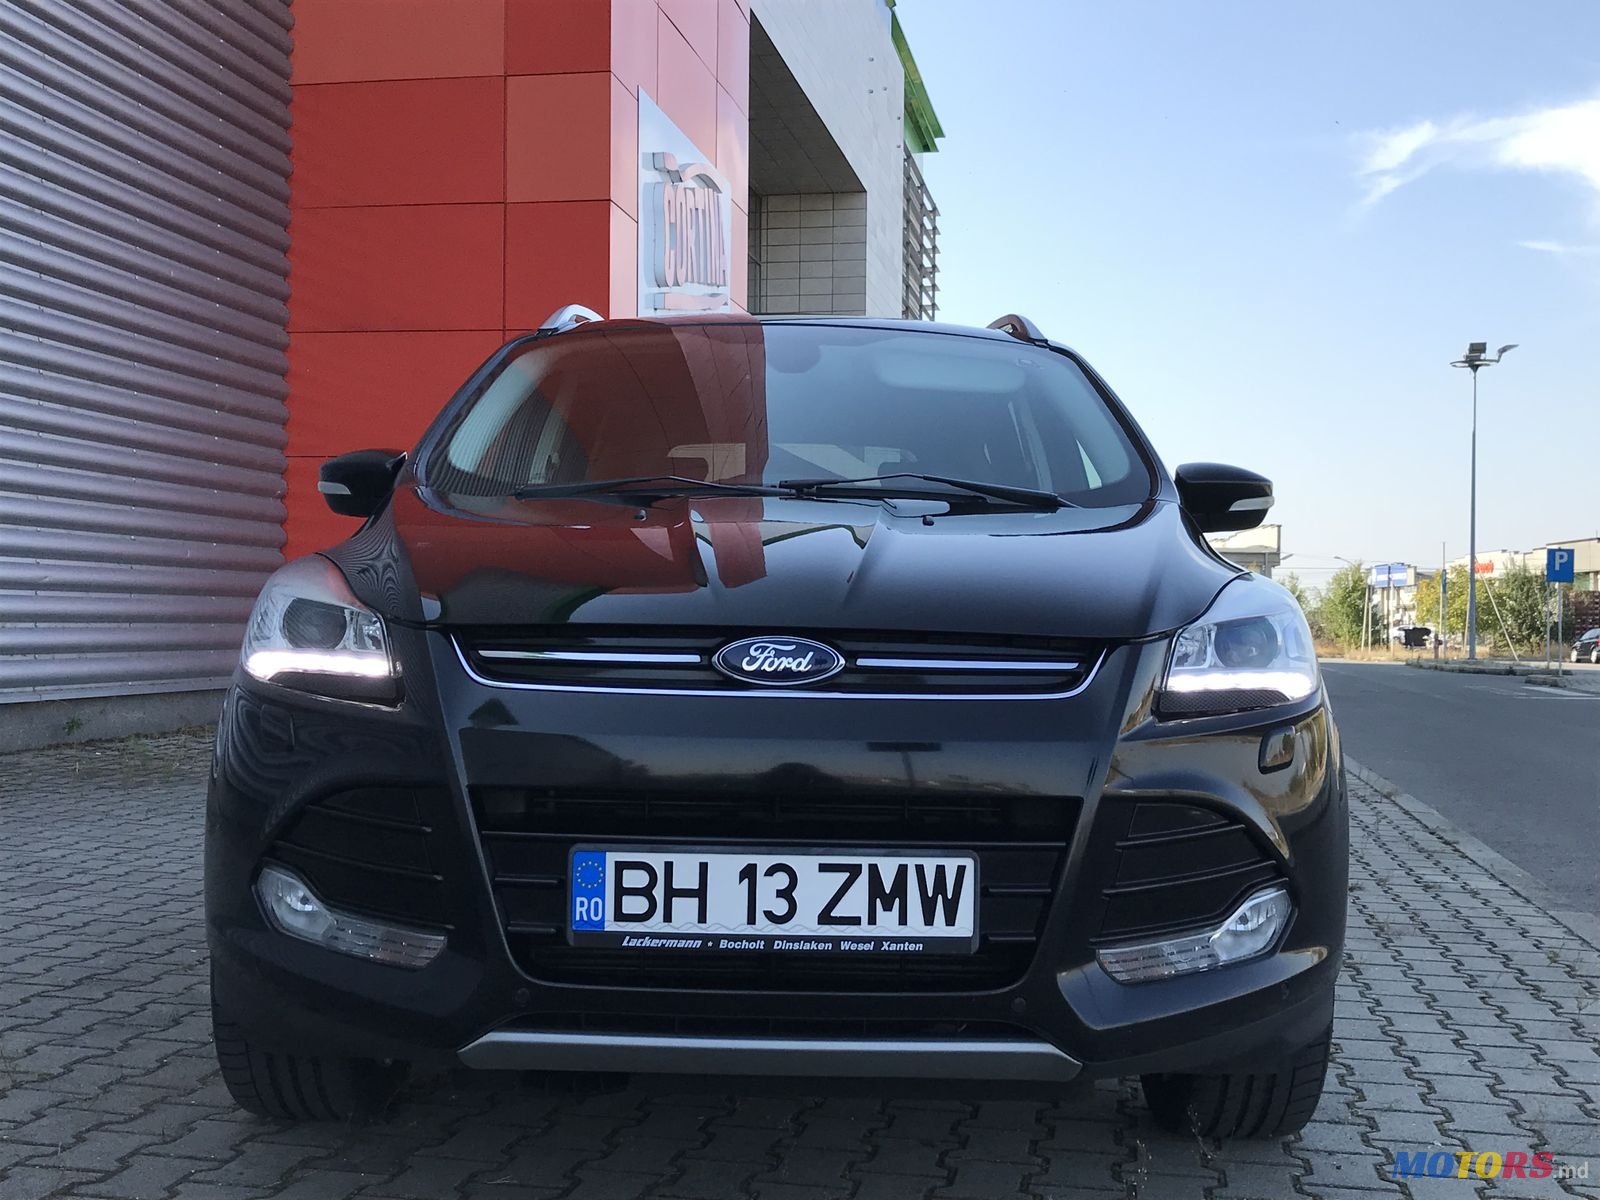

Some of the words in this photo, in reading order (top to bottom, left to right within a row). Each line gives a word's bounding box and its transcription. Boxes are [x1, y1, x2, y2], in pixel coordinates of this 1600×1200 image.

[662, 182, 727, 287] CORTINA
[1554, 551, 1569, 571] P
[741, 643, 814, 672] Ford
[613, 860, 709, 924] BH
[738, 862, 799, 926] 13
[816, 863, 968, 927] ZMW
[575, 896, 603, 922] RO
[622, 936, 702, 949] Lackermann
[719, 938, 765, 950] Bocholt
[773, 938, 833, 951] Dinslaken
[840, 940, 874, 951] Wesel
[880, 940, 923, 952] Xanten
